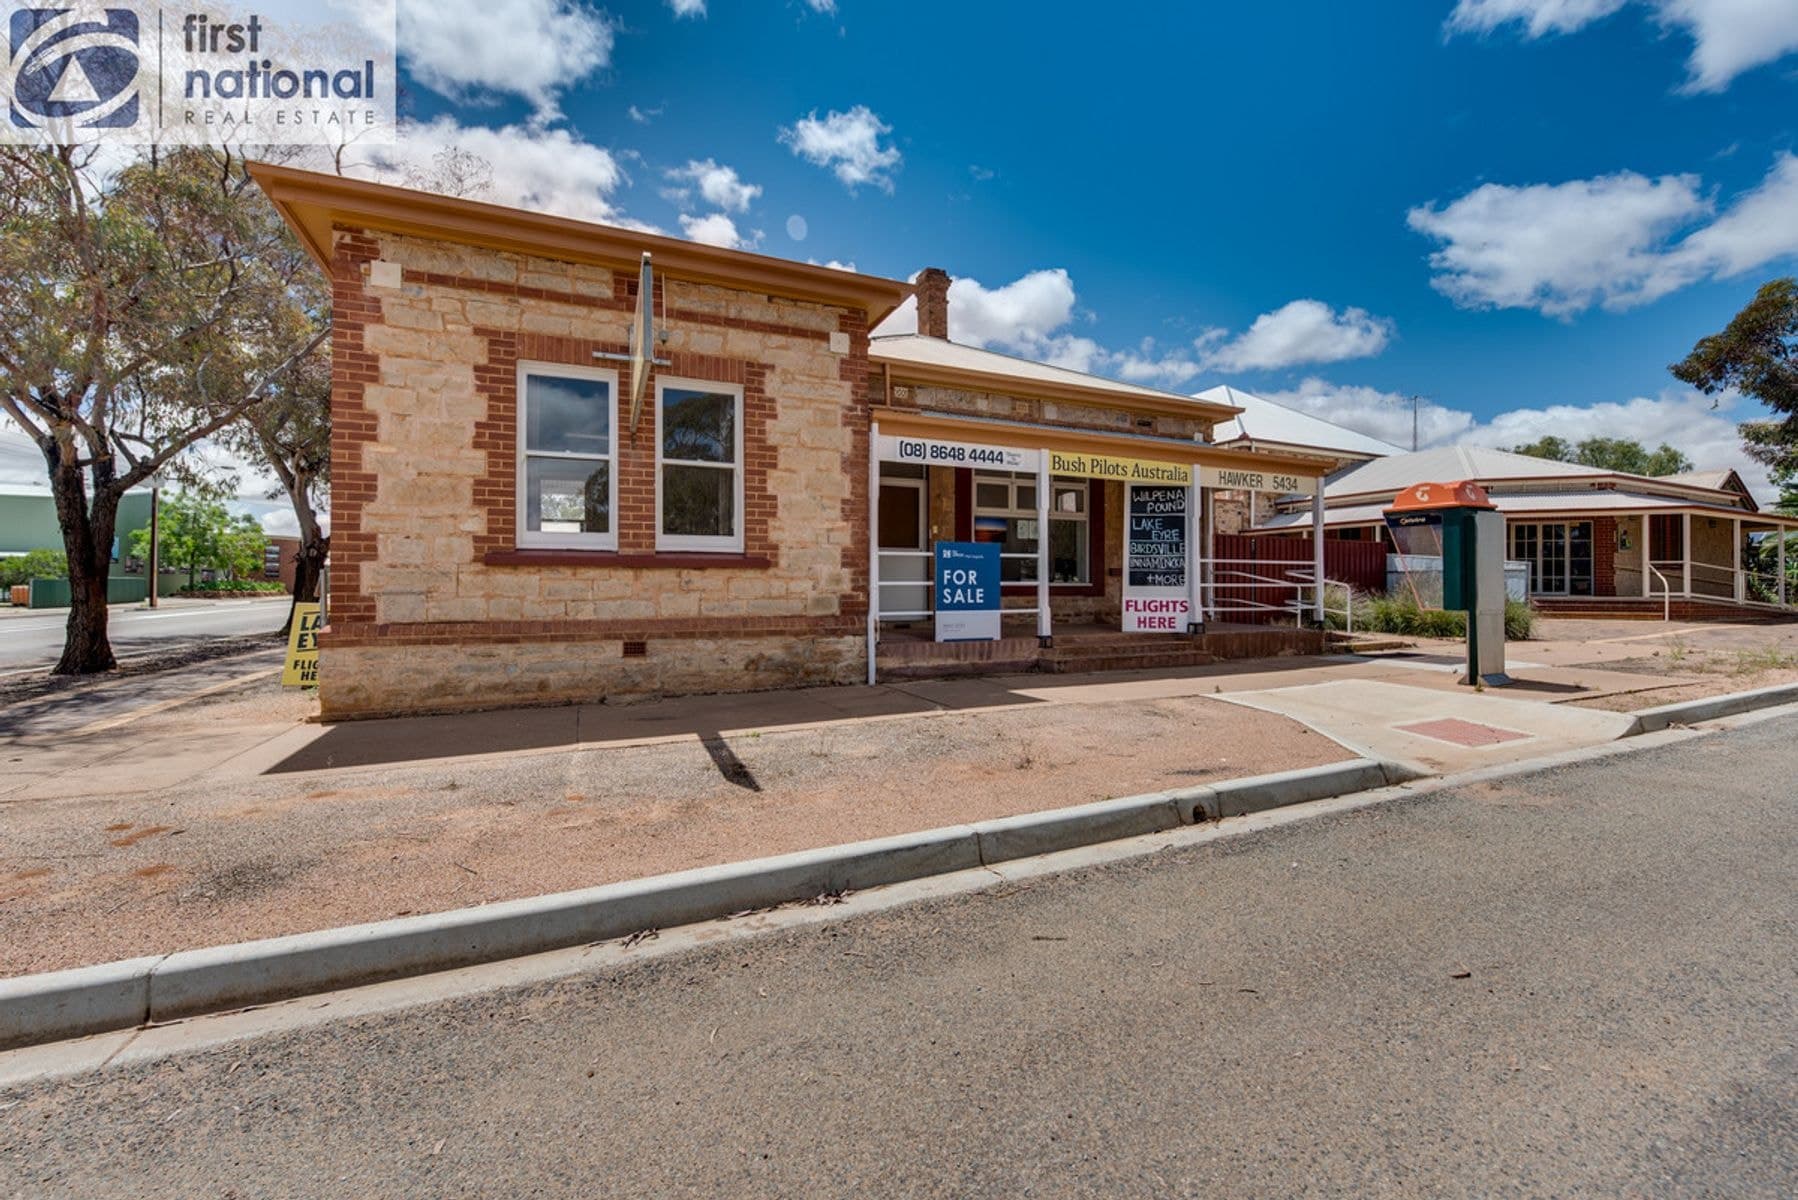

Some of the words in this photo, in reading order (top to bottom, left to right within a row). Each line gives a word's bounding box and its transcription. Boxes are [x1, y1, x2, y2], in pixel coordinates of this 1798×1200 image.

[900, 440, 926, 460] (08)
[930, 445, 965, 461] 8648
[968, 450, 1004, 464] 4444
[1052, 455, 1086, 473] Bush
[1090, 458, 1128, 476] Pilots
[1131, 463, 1188, 482] Australia
[1219, 470, 1263, 489] HAWKER
[1272, 475, 1298, 491] 5434
[1132, 489, 1185, 502] WILPENA
[1147, 500, 1185, 514] POUND
[1132, 518, 1163, 531] LAKE
[1152, 528, 1180, 541] EYRE
[1130, 542, 1186, 554] BIRDSVILLE
[943, 569, 977, 586] FOR
[942, 588, 985, 604] SALE
[1125, 599, 1189, 613] FLIGHTS
[301, 615, 320, 631] LA
[1137, 616, 1177, 629] HERE
[297, 632, 318, 649] EY
[301, 671, 318, 681] HE
